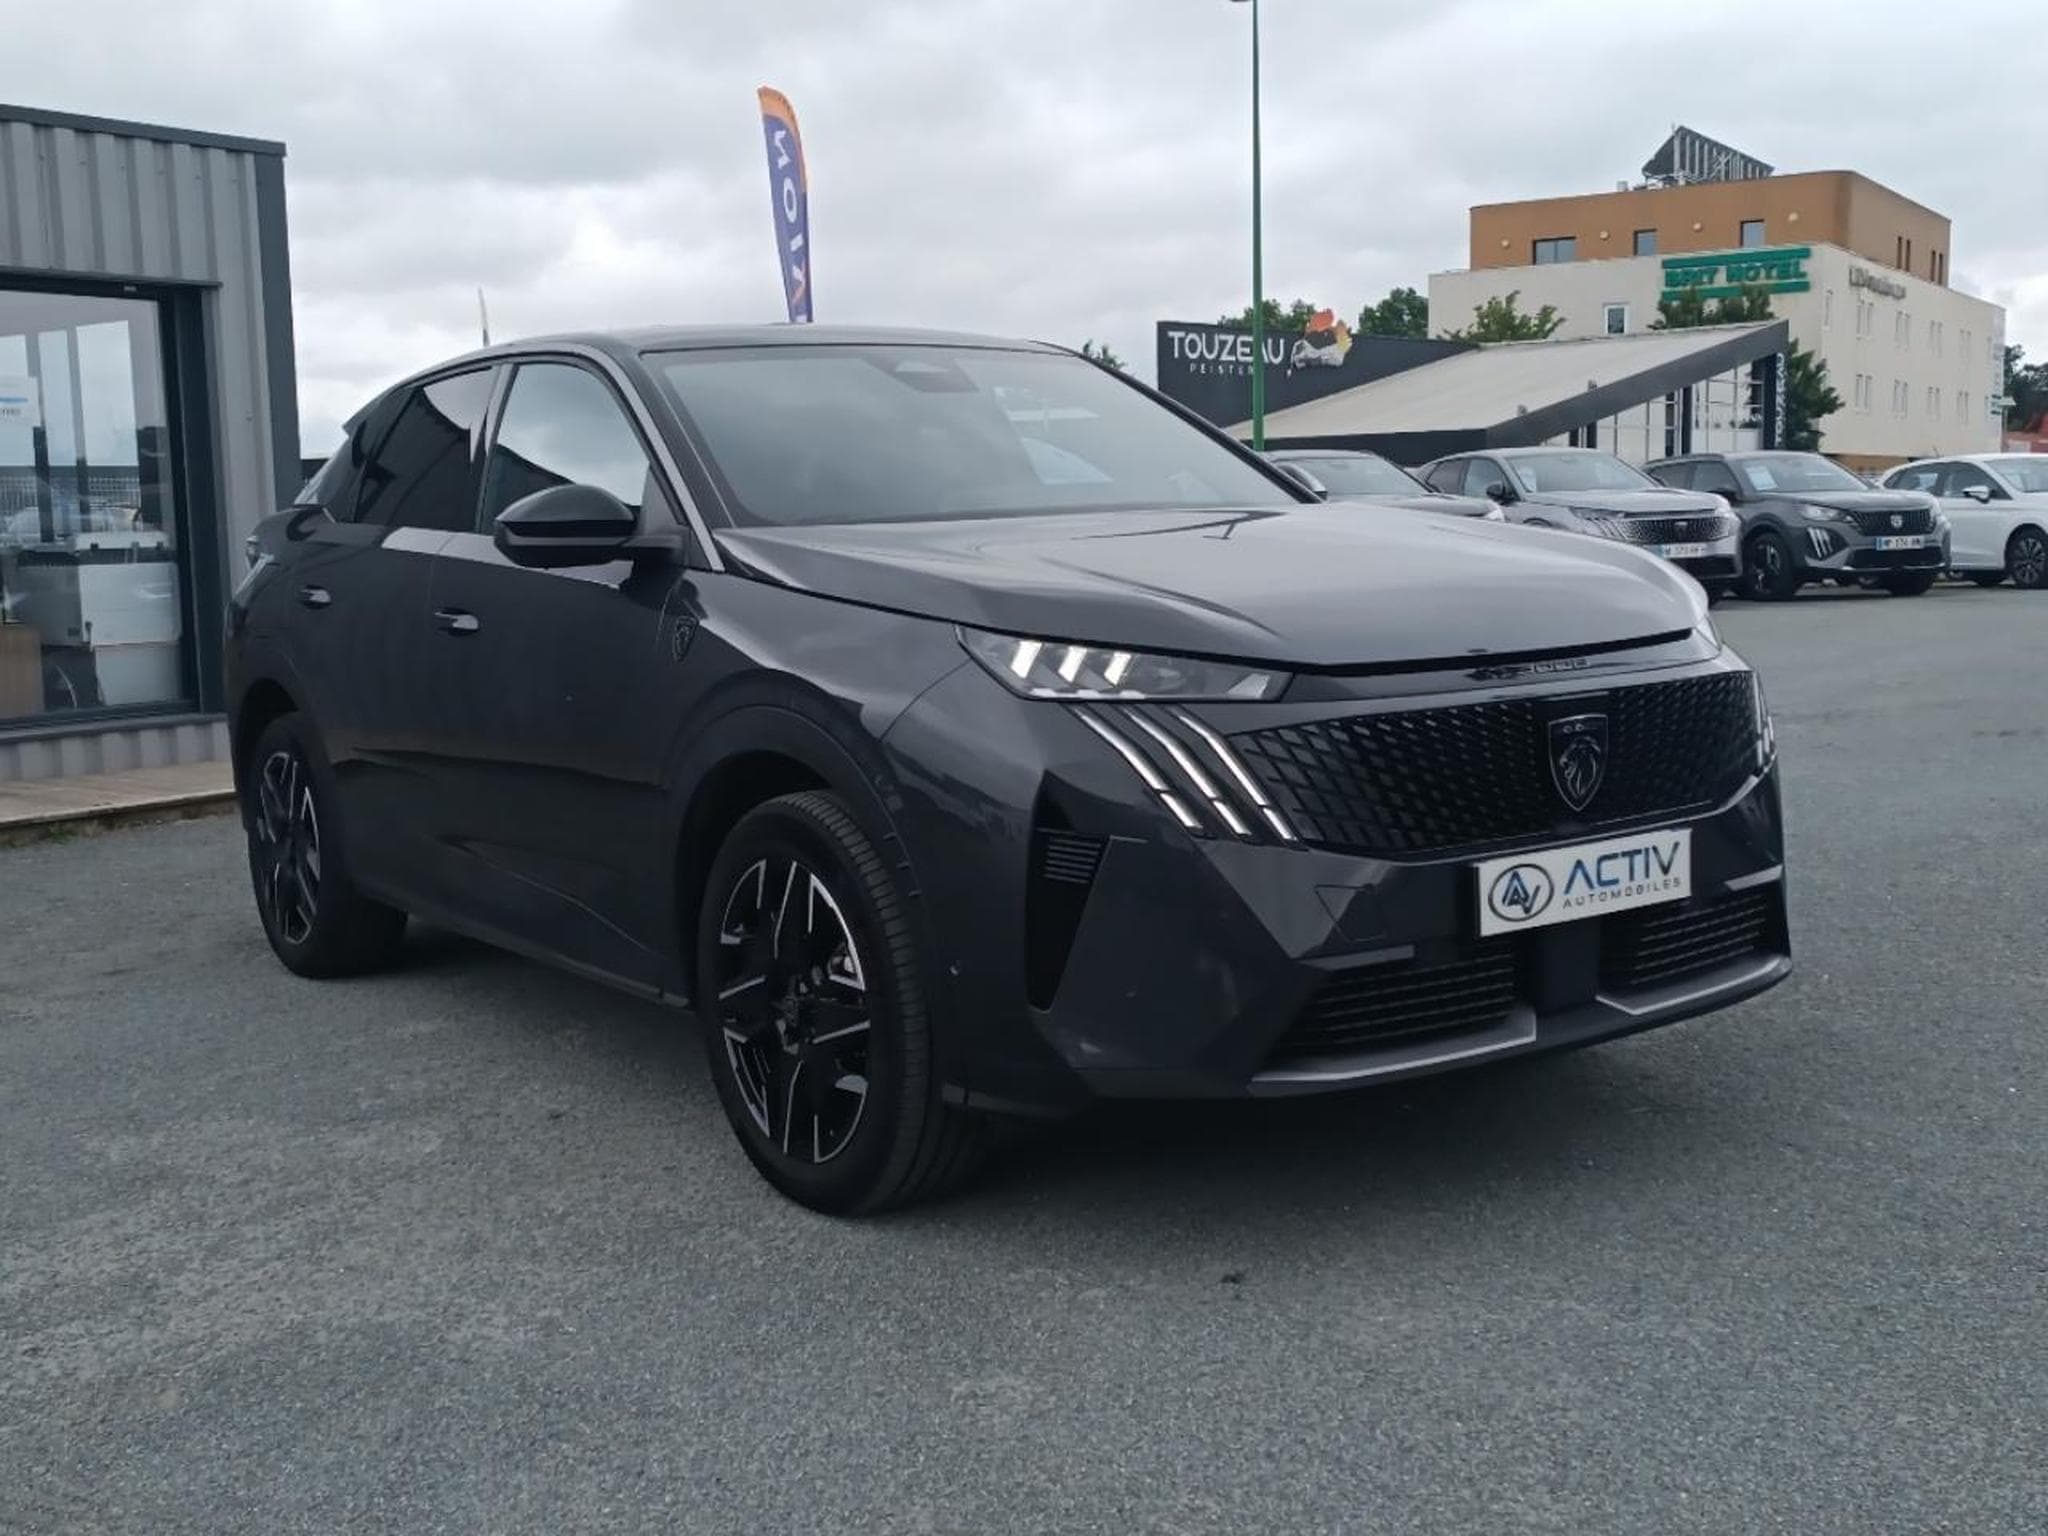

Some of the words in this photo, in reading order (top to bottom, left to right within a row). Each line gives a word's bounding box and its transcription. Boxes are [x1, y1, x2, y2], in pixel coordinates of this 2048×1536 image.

[1726, 258, 1808, 283] HOTEL
[1563, 840, 1681, 895] ACTIV
[1562, 876, 1682, 910] AUTOMOBILES
